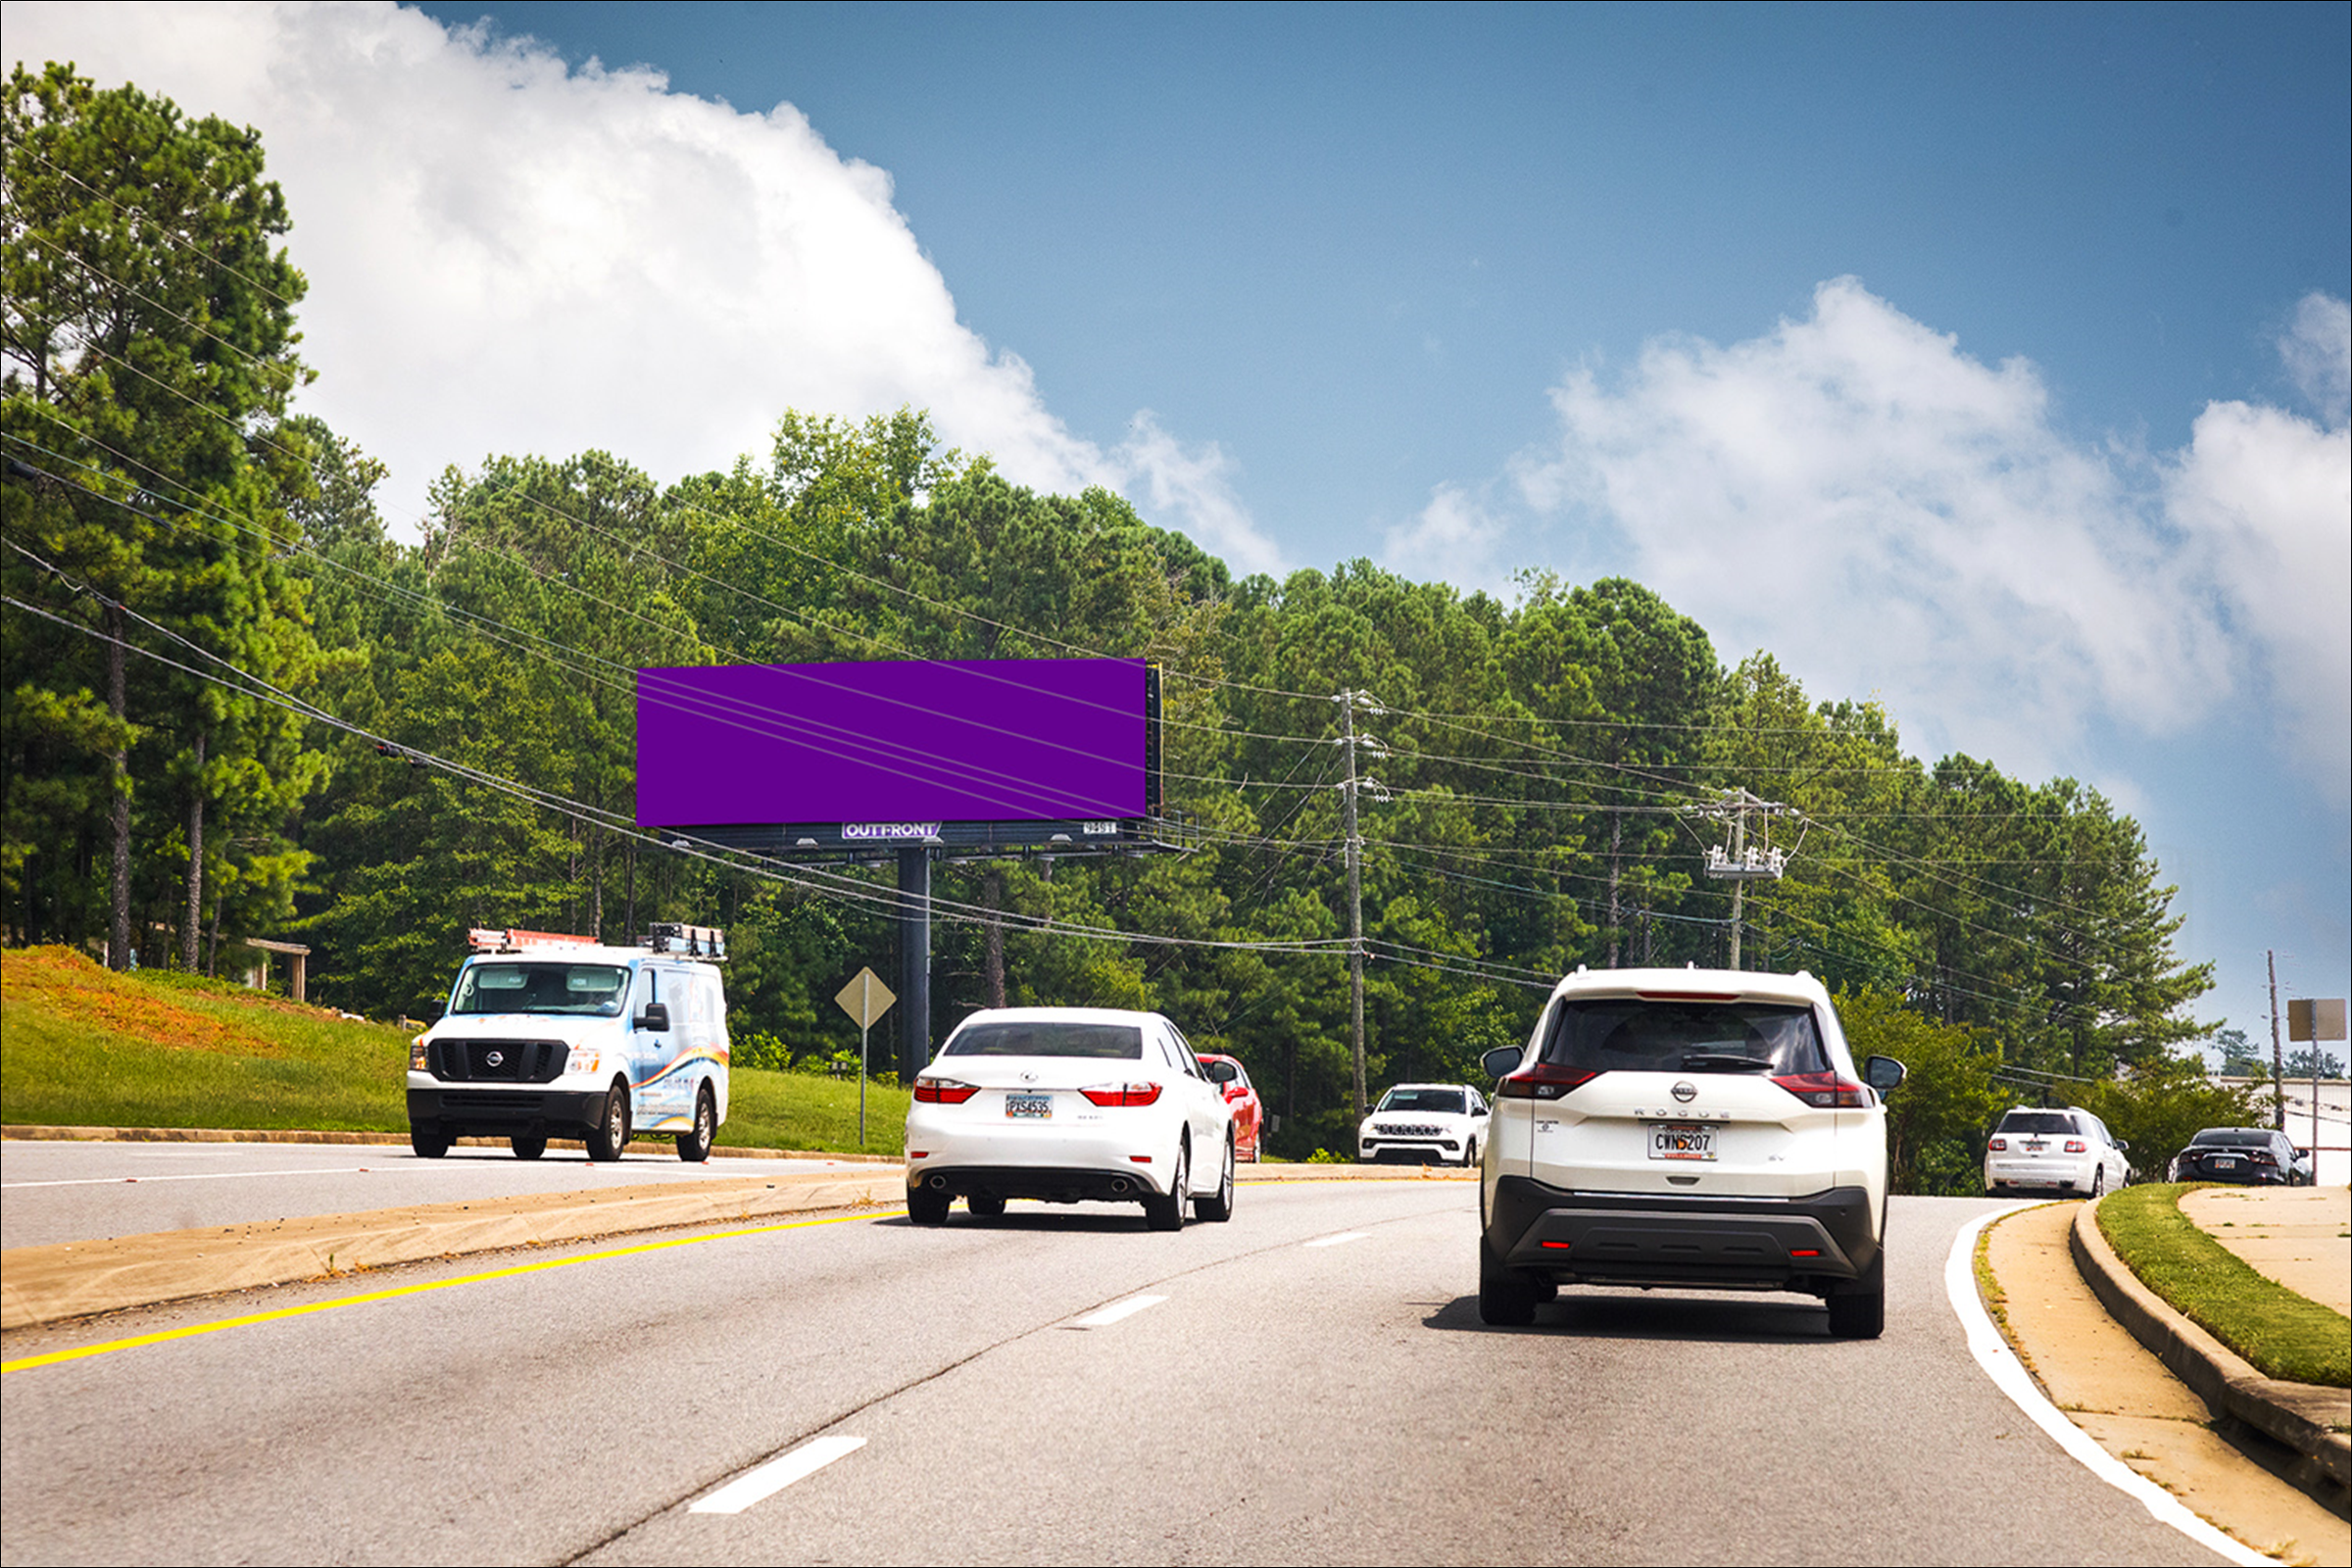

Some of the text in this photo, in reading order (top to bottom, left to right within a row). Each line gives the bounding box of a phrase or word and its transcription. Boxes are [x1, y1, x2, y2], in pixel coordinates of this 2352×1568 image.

[846, 823, 937, 837] OUTFRONT
[1634, 1107, 1731, 1119] ROGUE
[1655, 1133, 1711, 1152] CWN5207
